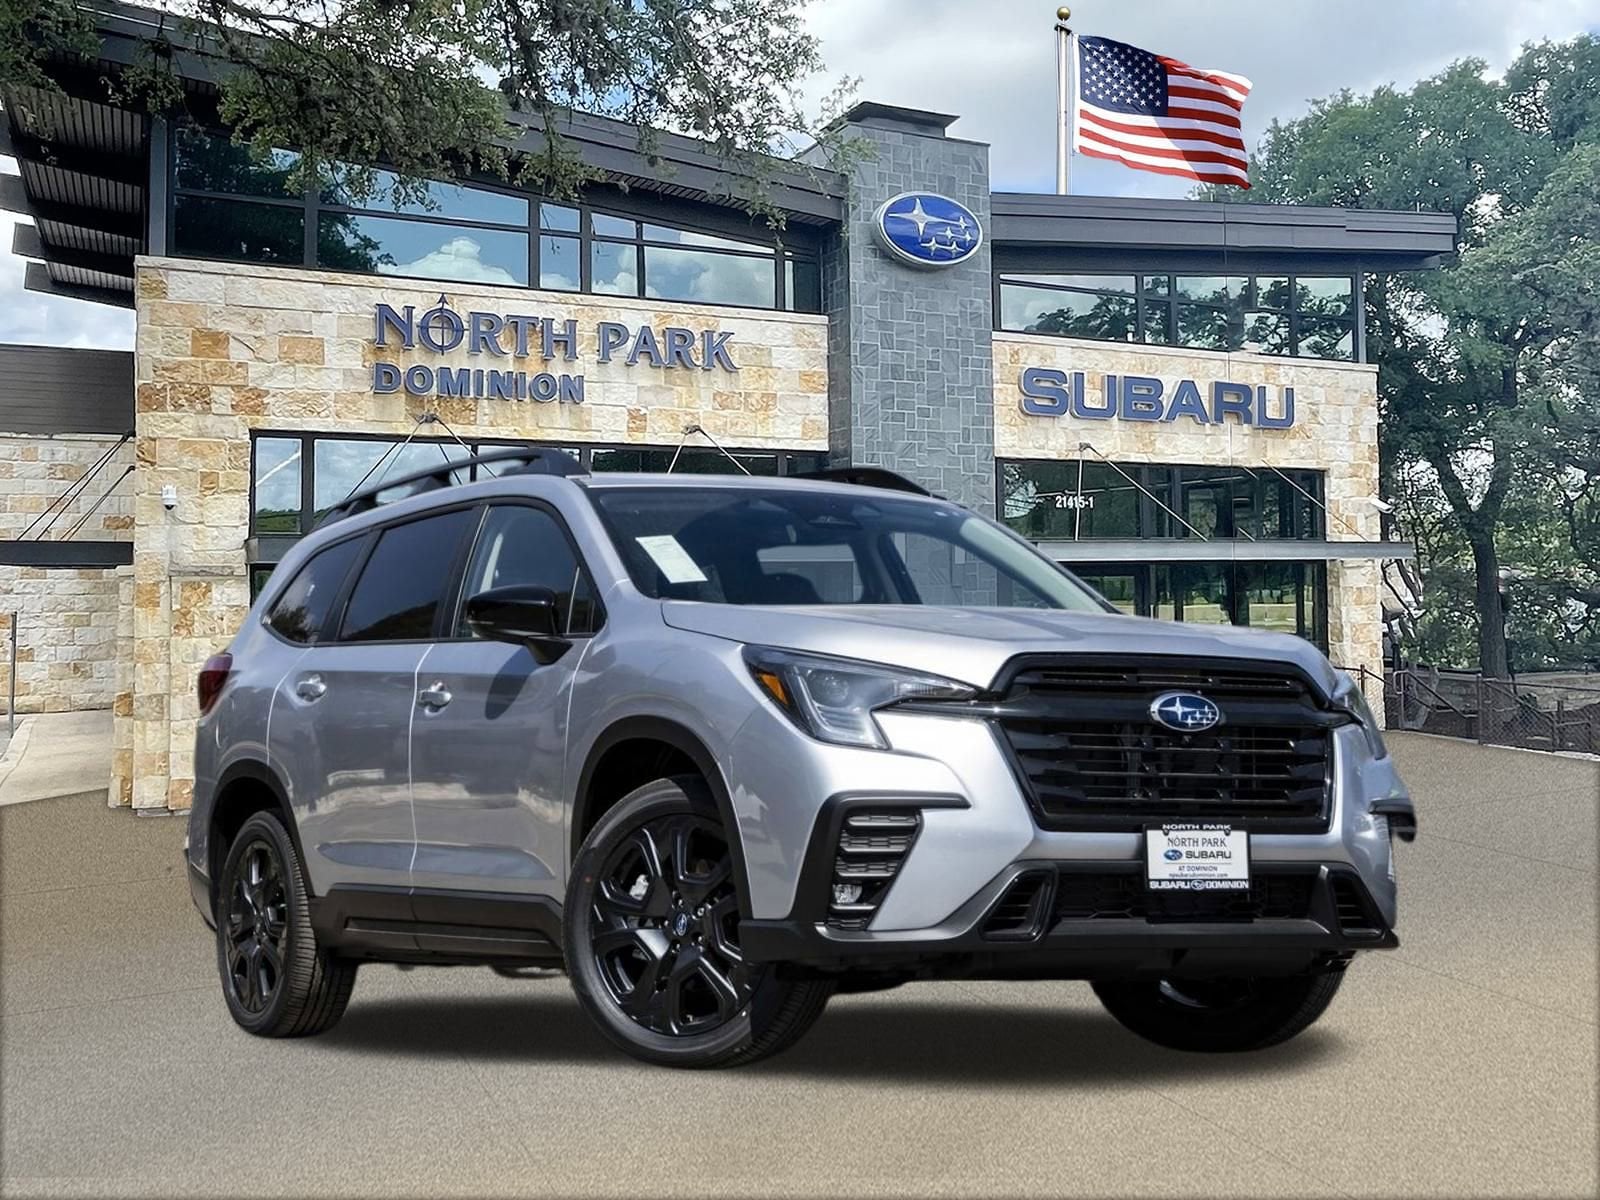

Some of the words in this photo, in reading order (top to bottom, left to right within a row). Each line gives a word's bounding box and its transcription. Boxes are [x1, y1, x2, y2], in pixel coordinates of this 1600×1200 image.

[374, 294, 579, 362] NORTH
[597, 321, 742, 373] PARK
[373, 362, 585, 404] DOMINION
[1018, 367, 1295, 430] SUBARU
[1167, 836, 1199, 847] NORTH
[1201, 837, 1227, 847] PARK
[1185, 850, 1231, 859] SUBARU
[1149, 880, 1190, 889] SUBARU
[1205, 880, 1249, 889] DOMINION
